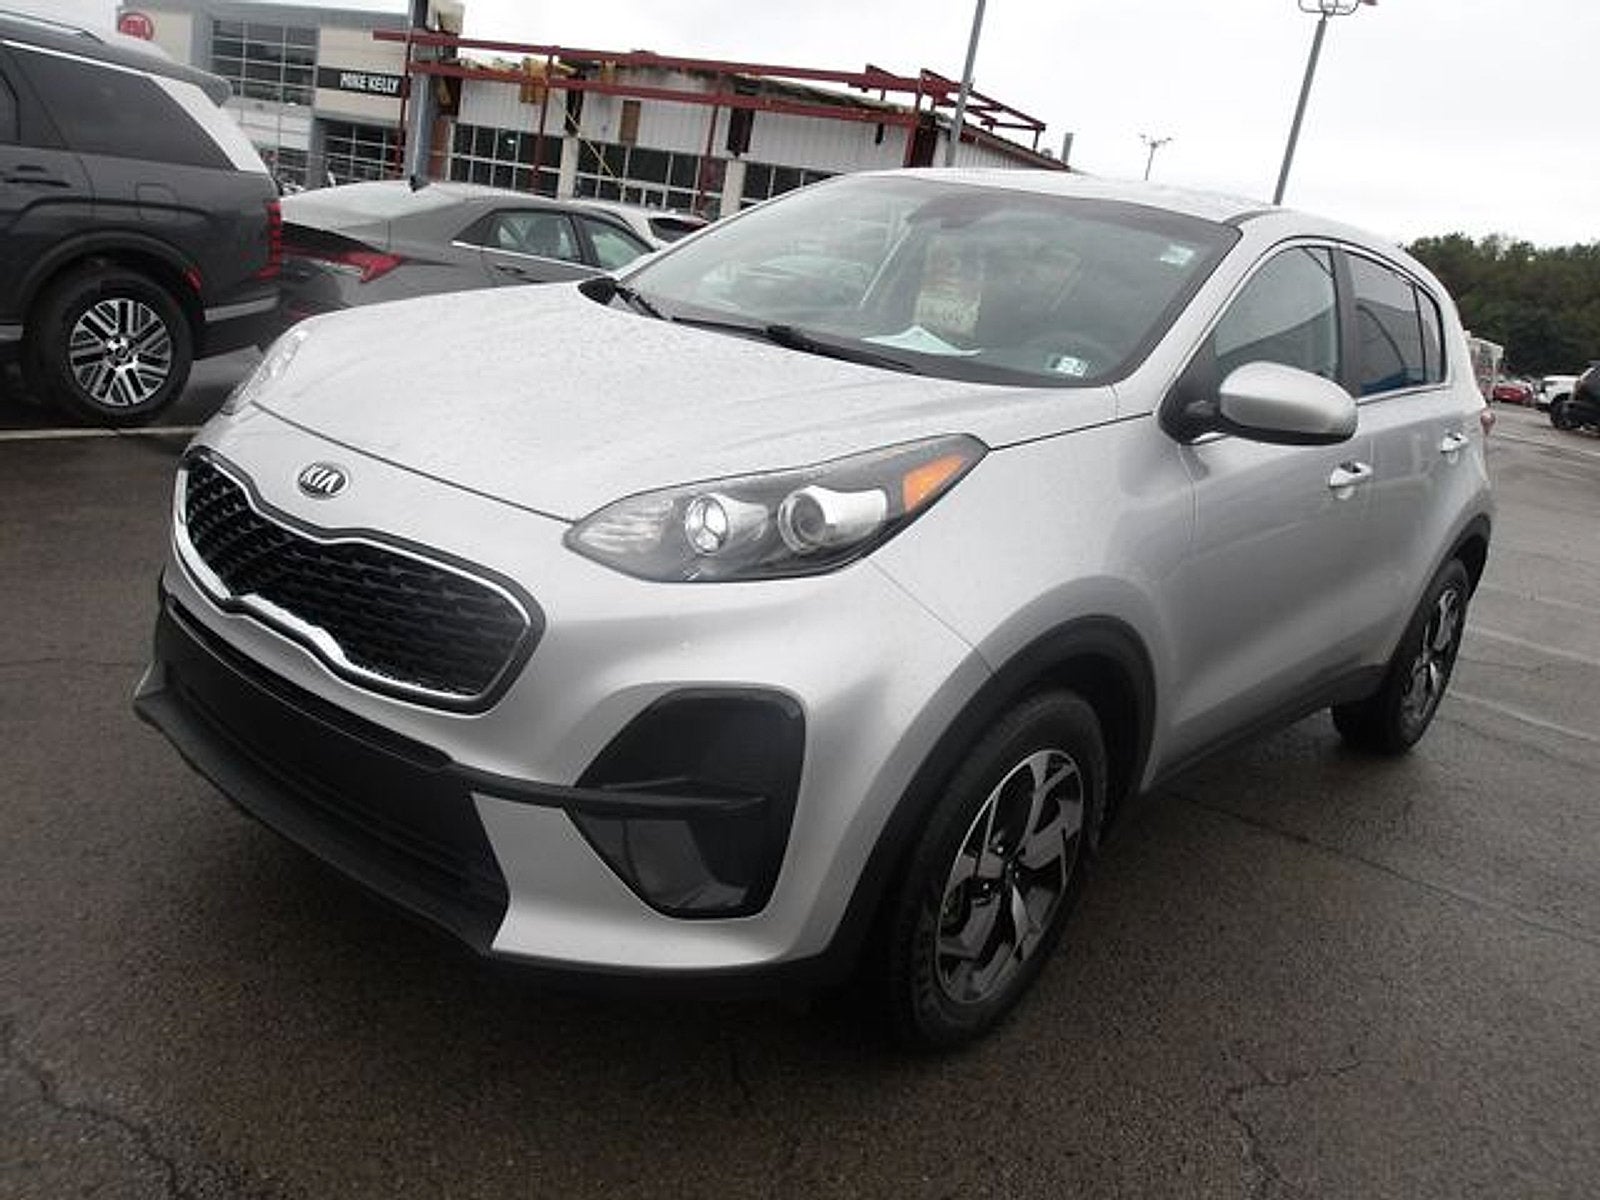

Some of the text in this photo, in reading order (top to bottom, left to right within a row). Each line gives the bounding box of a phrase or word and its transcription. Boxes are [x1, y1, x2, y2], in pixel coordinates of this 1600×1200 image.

[340, 72, 399, 94] MIKE KELLY
[300, 465, 340, 491] KIA
